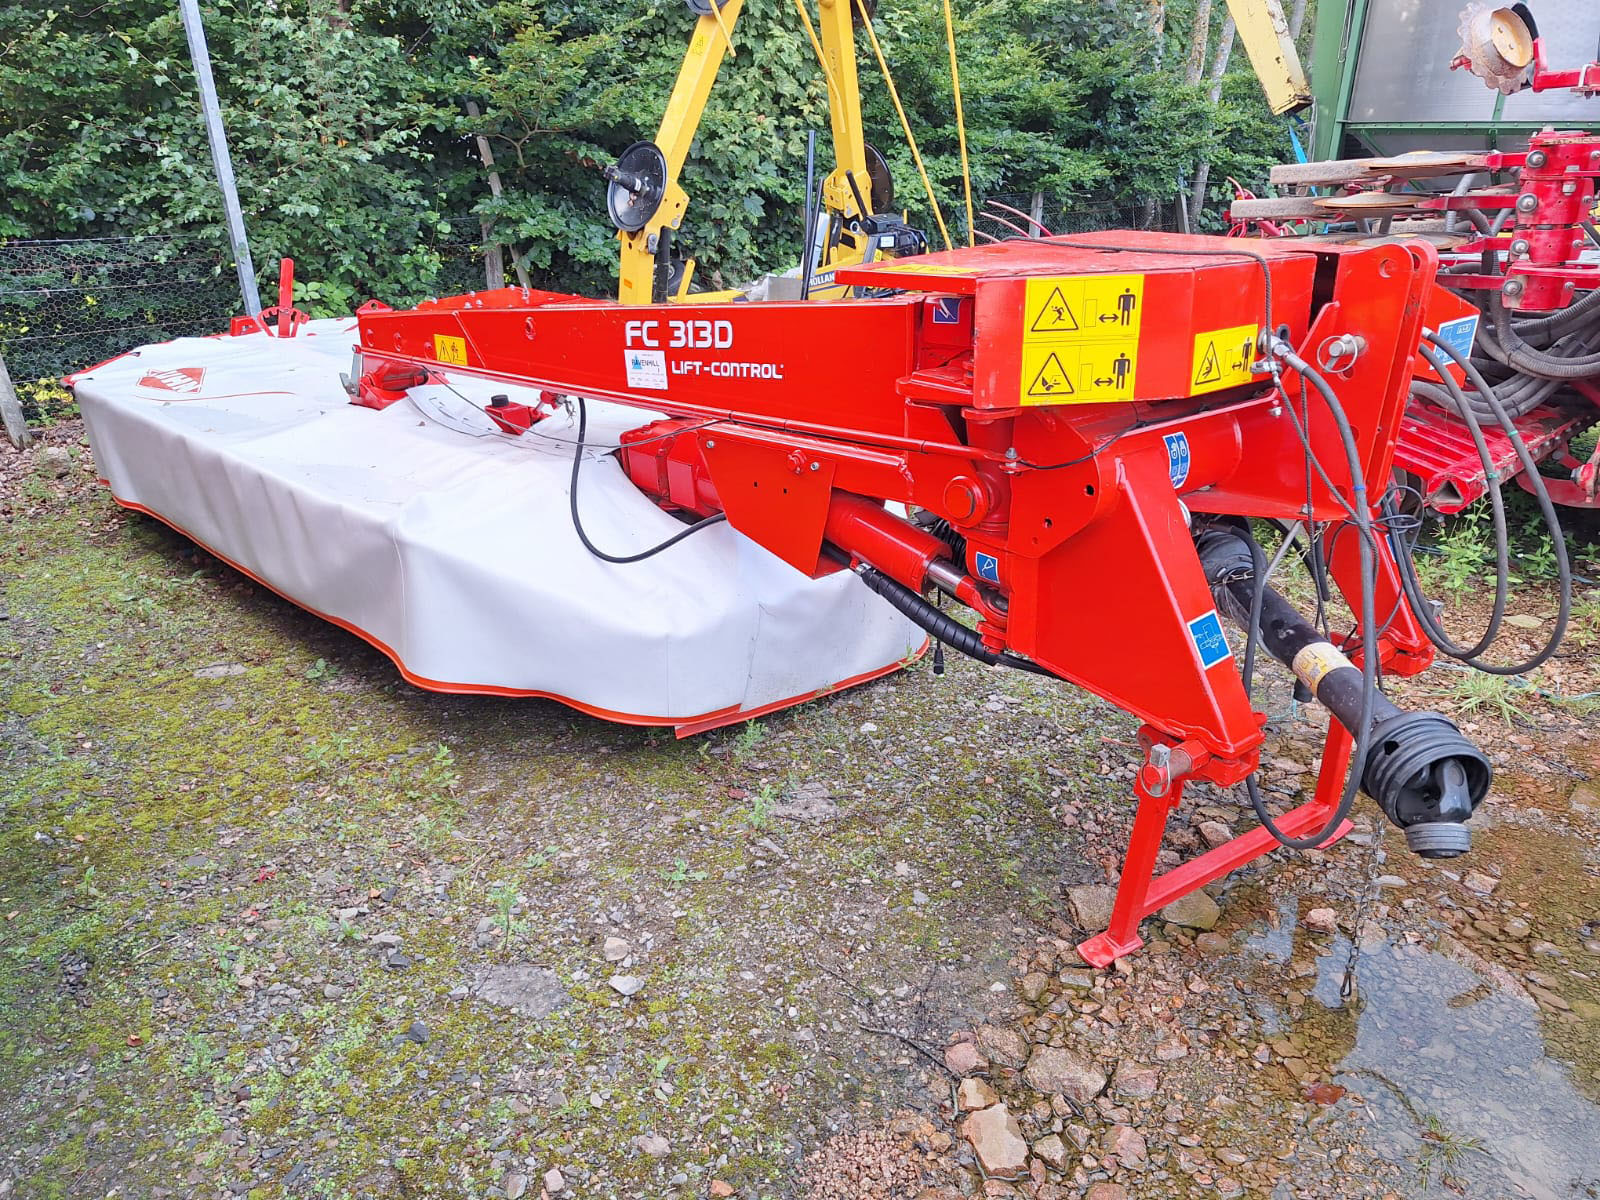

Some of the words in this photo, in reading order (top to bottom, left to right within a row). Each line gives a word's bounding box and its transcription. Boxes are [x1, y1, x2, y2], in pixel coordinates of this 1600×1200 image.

[809, 271, 835, 287] HOLLAN
[625, 320, 659, 347] FC
[668, 320, 733, 349] 313D
[671, 360, 783, 379] LIFT-CONTROL
